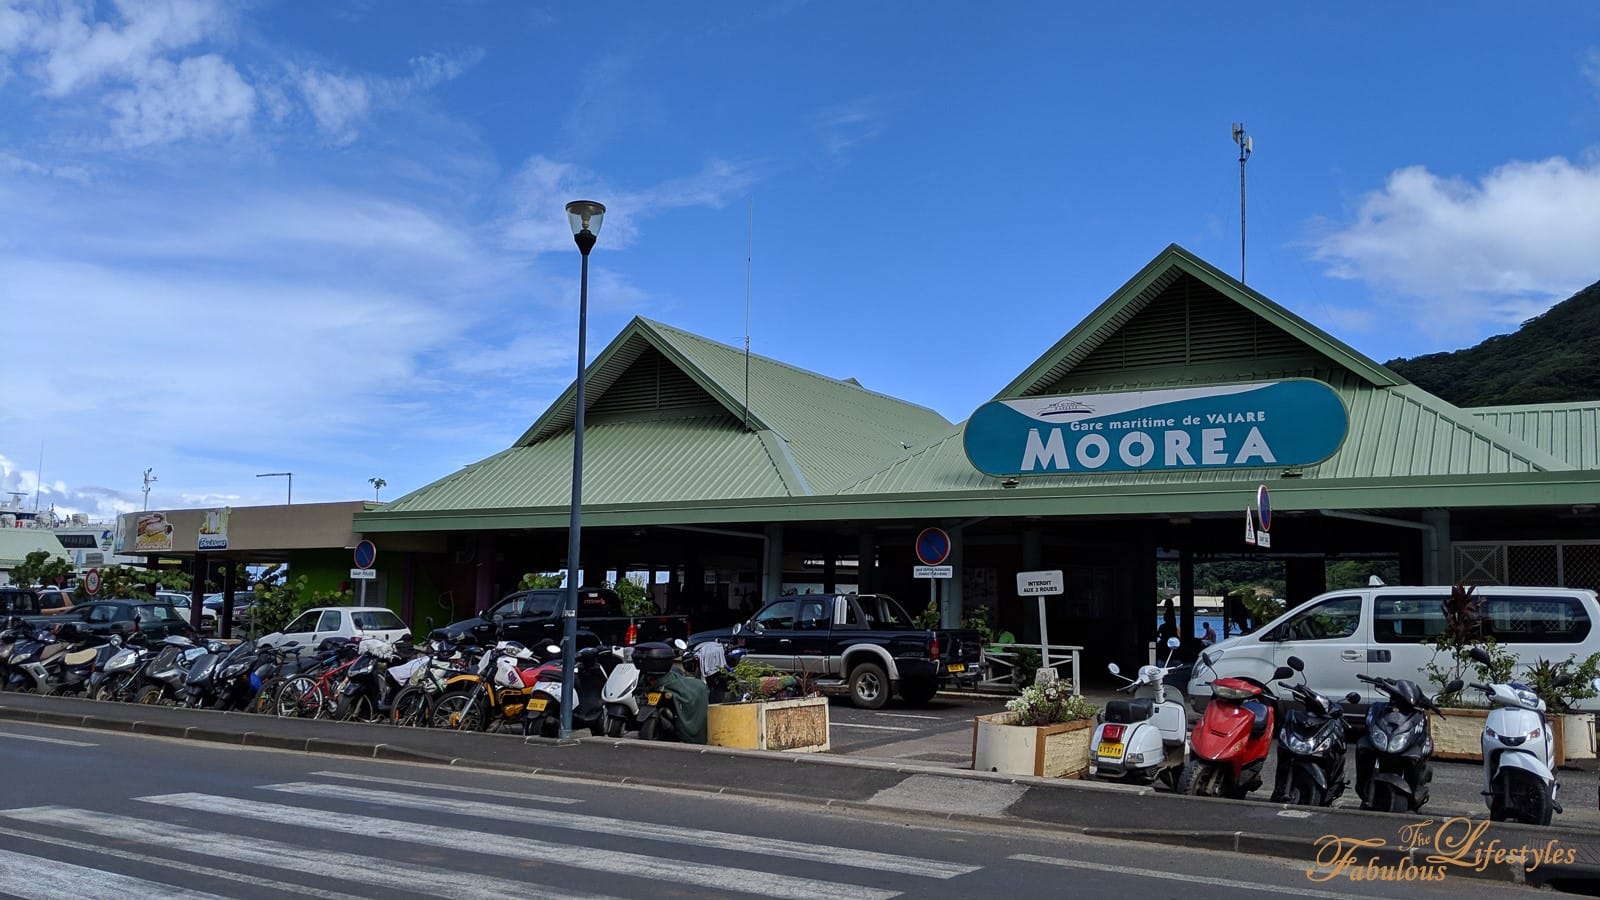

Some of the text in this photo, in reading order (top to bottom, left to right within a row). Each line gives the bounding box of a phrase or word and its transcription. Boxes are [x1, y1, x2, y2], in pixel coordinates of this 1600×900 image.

[1070, 412, 1266, 431] Gare maritime de VAIARE
[1020, 426, 1277, 471] MOOREA
